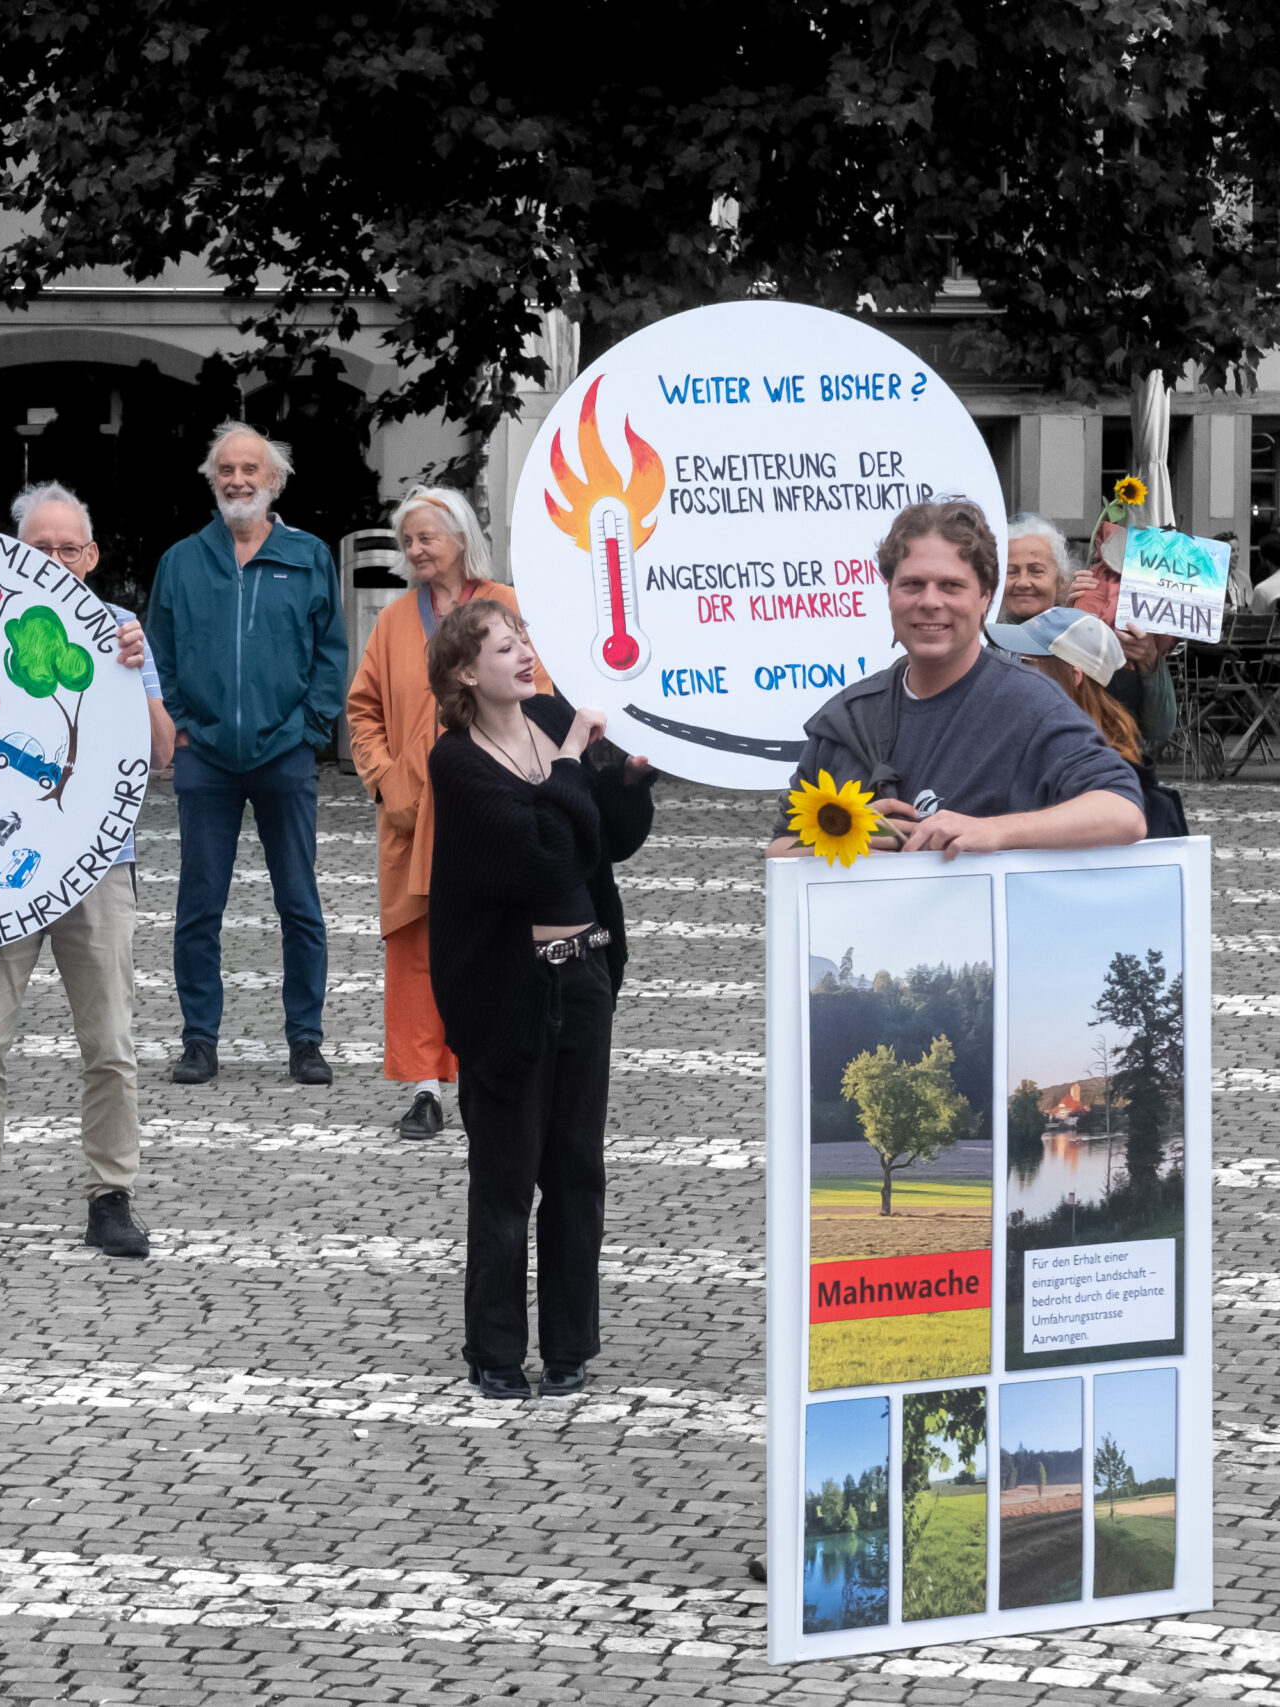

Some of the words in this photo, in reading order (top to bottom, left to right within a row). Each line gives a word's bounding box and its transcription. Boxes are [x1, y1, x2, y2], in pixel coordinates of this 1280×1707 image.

[658, 373, 750, 404] WEITER
[763, 375, 806, 403] WIE
[820, 373, 902, 402] BISHER
[675, 453, 837, 482] ERWEITERUNG
[858, 451, 905, 478] DER
[670, 486, 765, 514] FOSSILEN
[773, 482, 934, 513] INFRASTRUKTUR
[646, 562, 775, 591] ANGESICHTS
[784, 560, 826, 588] DER
[834, 559, 888, 586] DRIN
[1140, 549, 1201, 578] WALD
[1156, 578, 1198, 593] STATT
[697, 594, 734, 624] DER
[749, 591, 868, 622] KLIMAKRISE
[1131, 592, 1212, 637] WAHN
[661, 665, 729, 698] KEINE
[754, 663, 846, 691] OPTION
[1032, 1257, 1049, 1270] Für
[1052, 1256, 1071, 1269] den
[1073, 1252, 1101, 1266] Erhalt
[1104, 1252, 1128, 1263] einer
[817, 1269, 980, 1308] Mahnwache
[1032, 1274, 1093, 1289] einzigartigen
[1096, 1267, 1147, 1283] Landschaft
[1032, 1293, 1072, 1307] bedroht
[1074, 1290, 1102, 1303] durch
[1105, 1289, 1120, 1300] die
[1122, 1286, 1165, 1301] geplante
[1032, 1309, 1124, 1325] Umfahrungsstrasse
[1032, 1331, 1089, 1345] Aarwangen.
